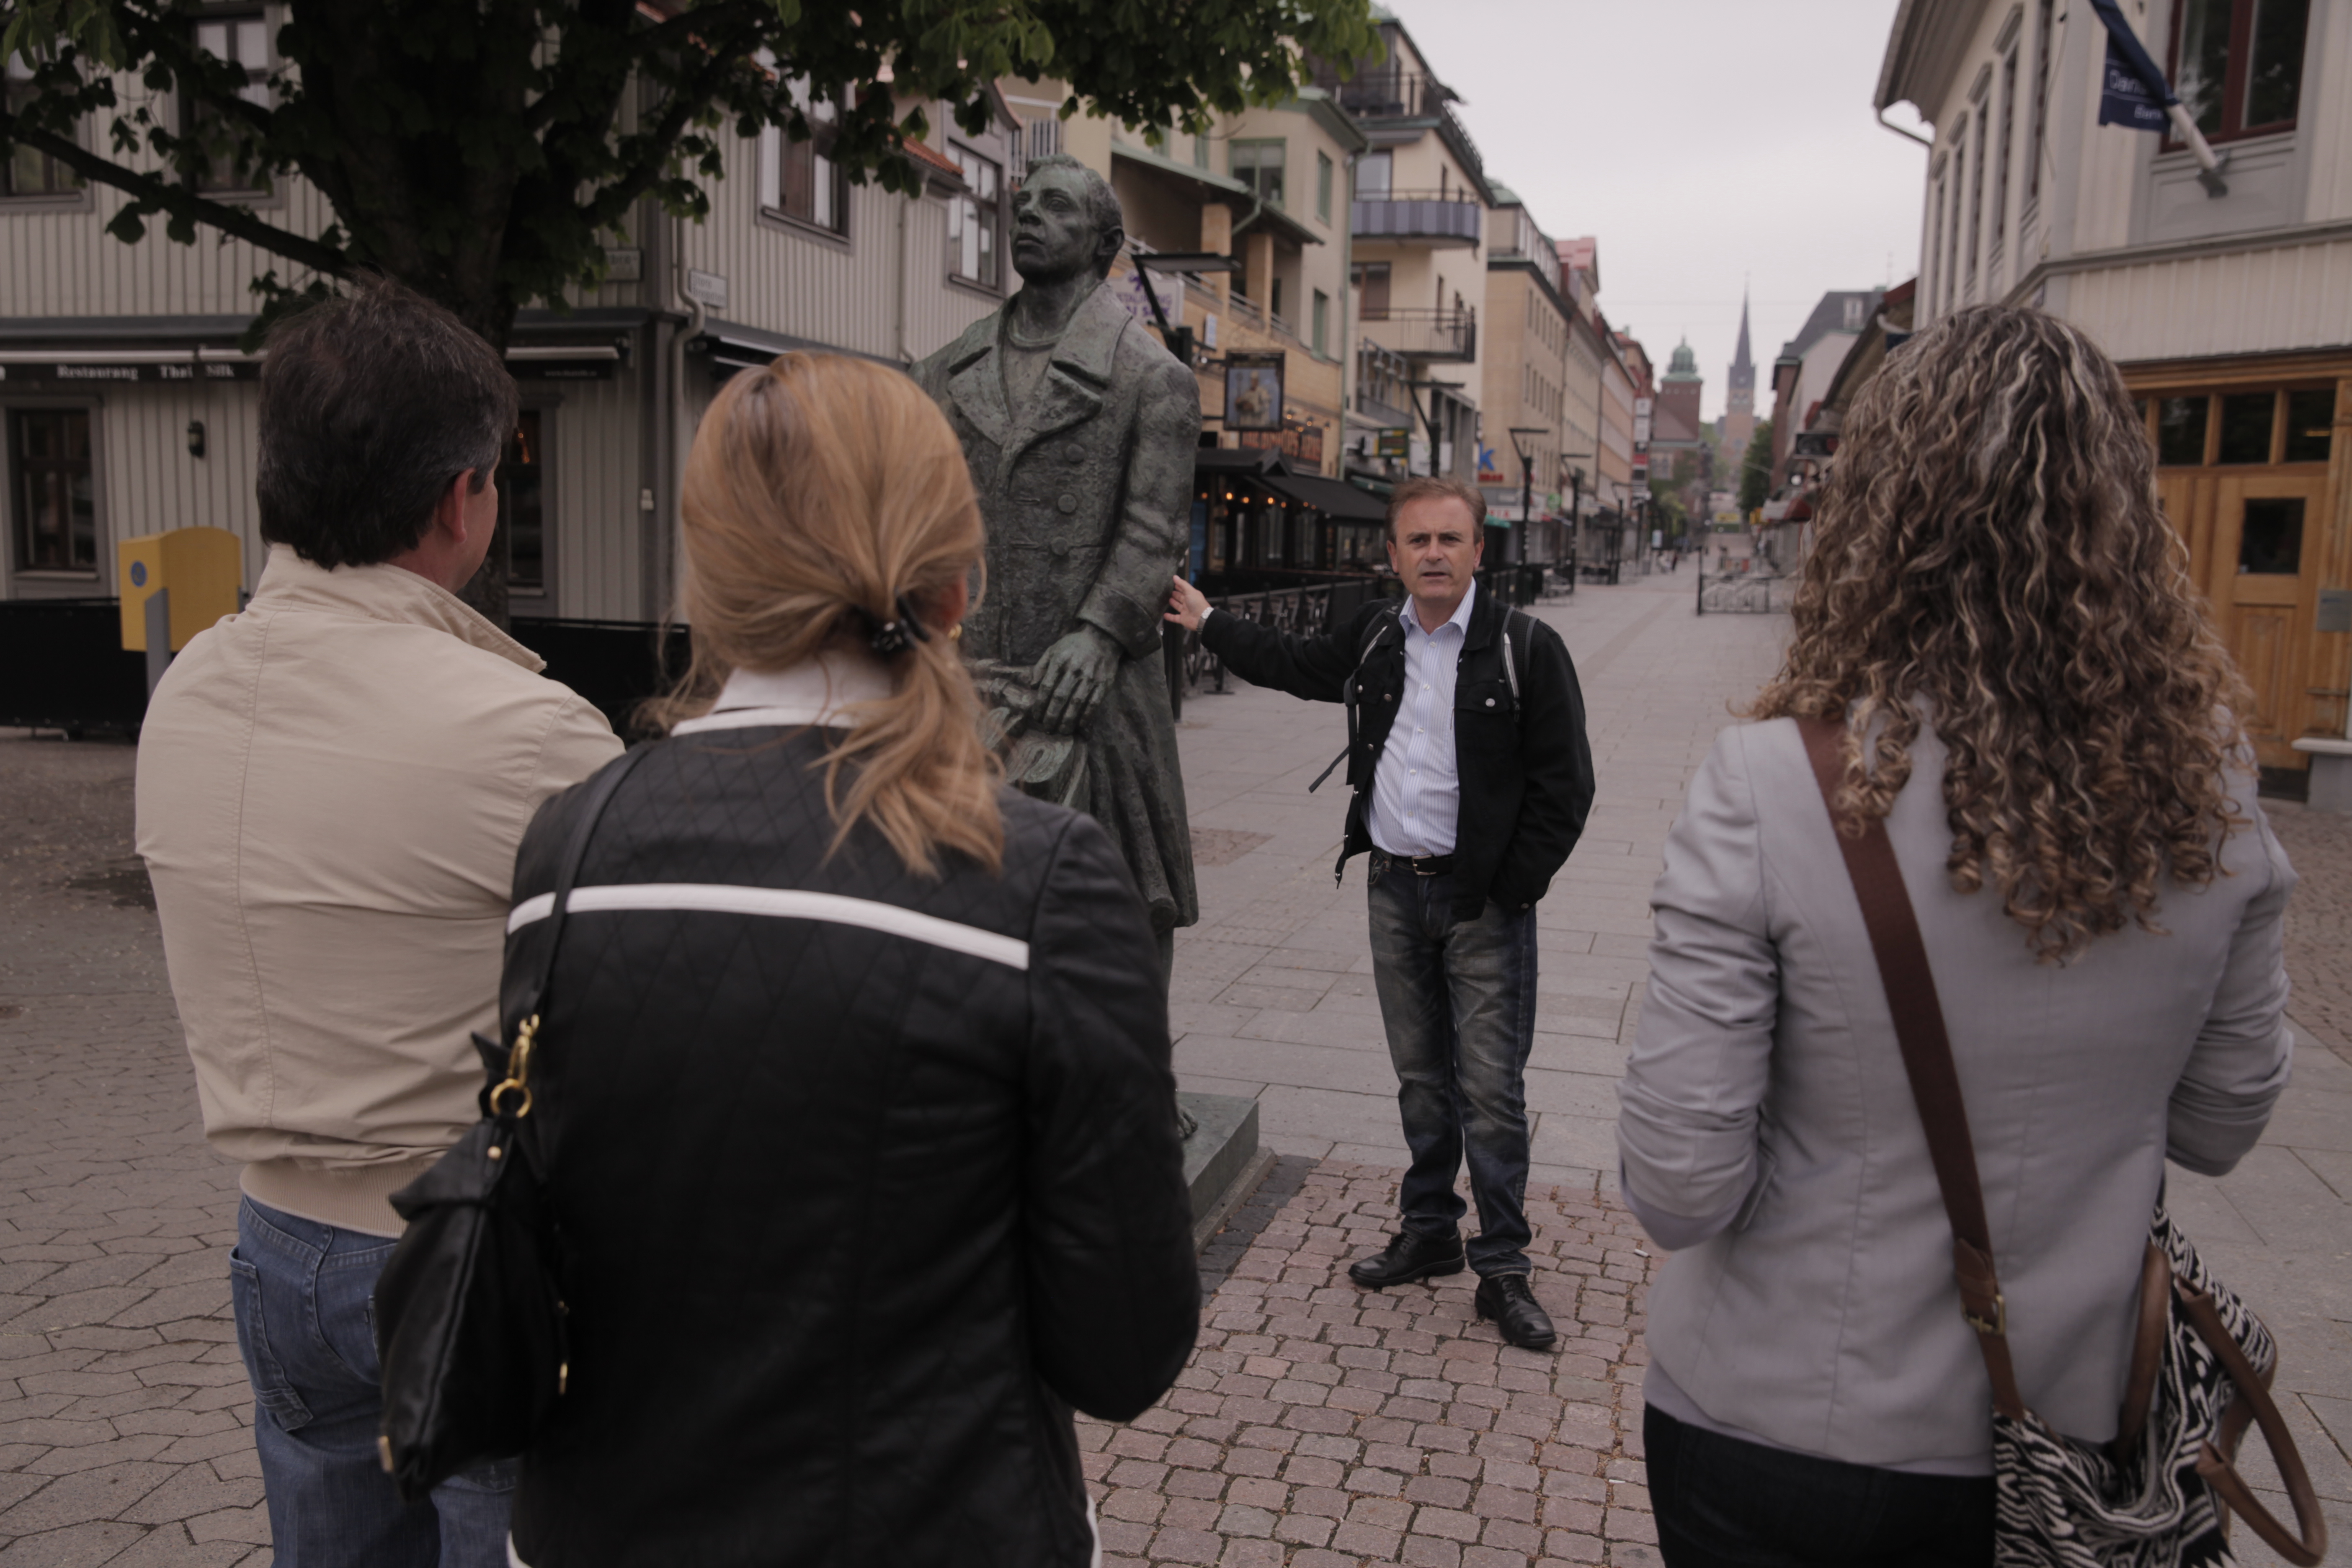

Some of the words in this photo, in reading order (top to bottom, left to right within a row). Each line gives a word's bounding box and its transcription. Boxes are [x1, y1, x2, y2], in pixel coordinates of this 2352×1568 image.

[57, 364, 139, 382] Restaurang
[158, 364, 193, 378] Thai
[205, 363, 235, 377] Silk
